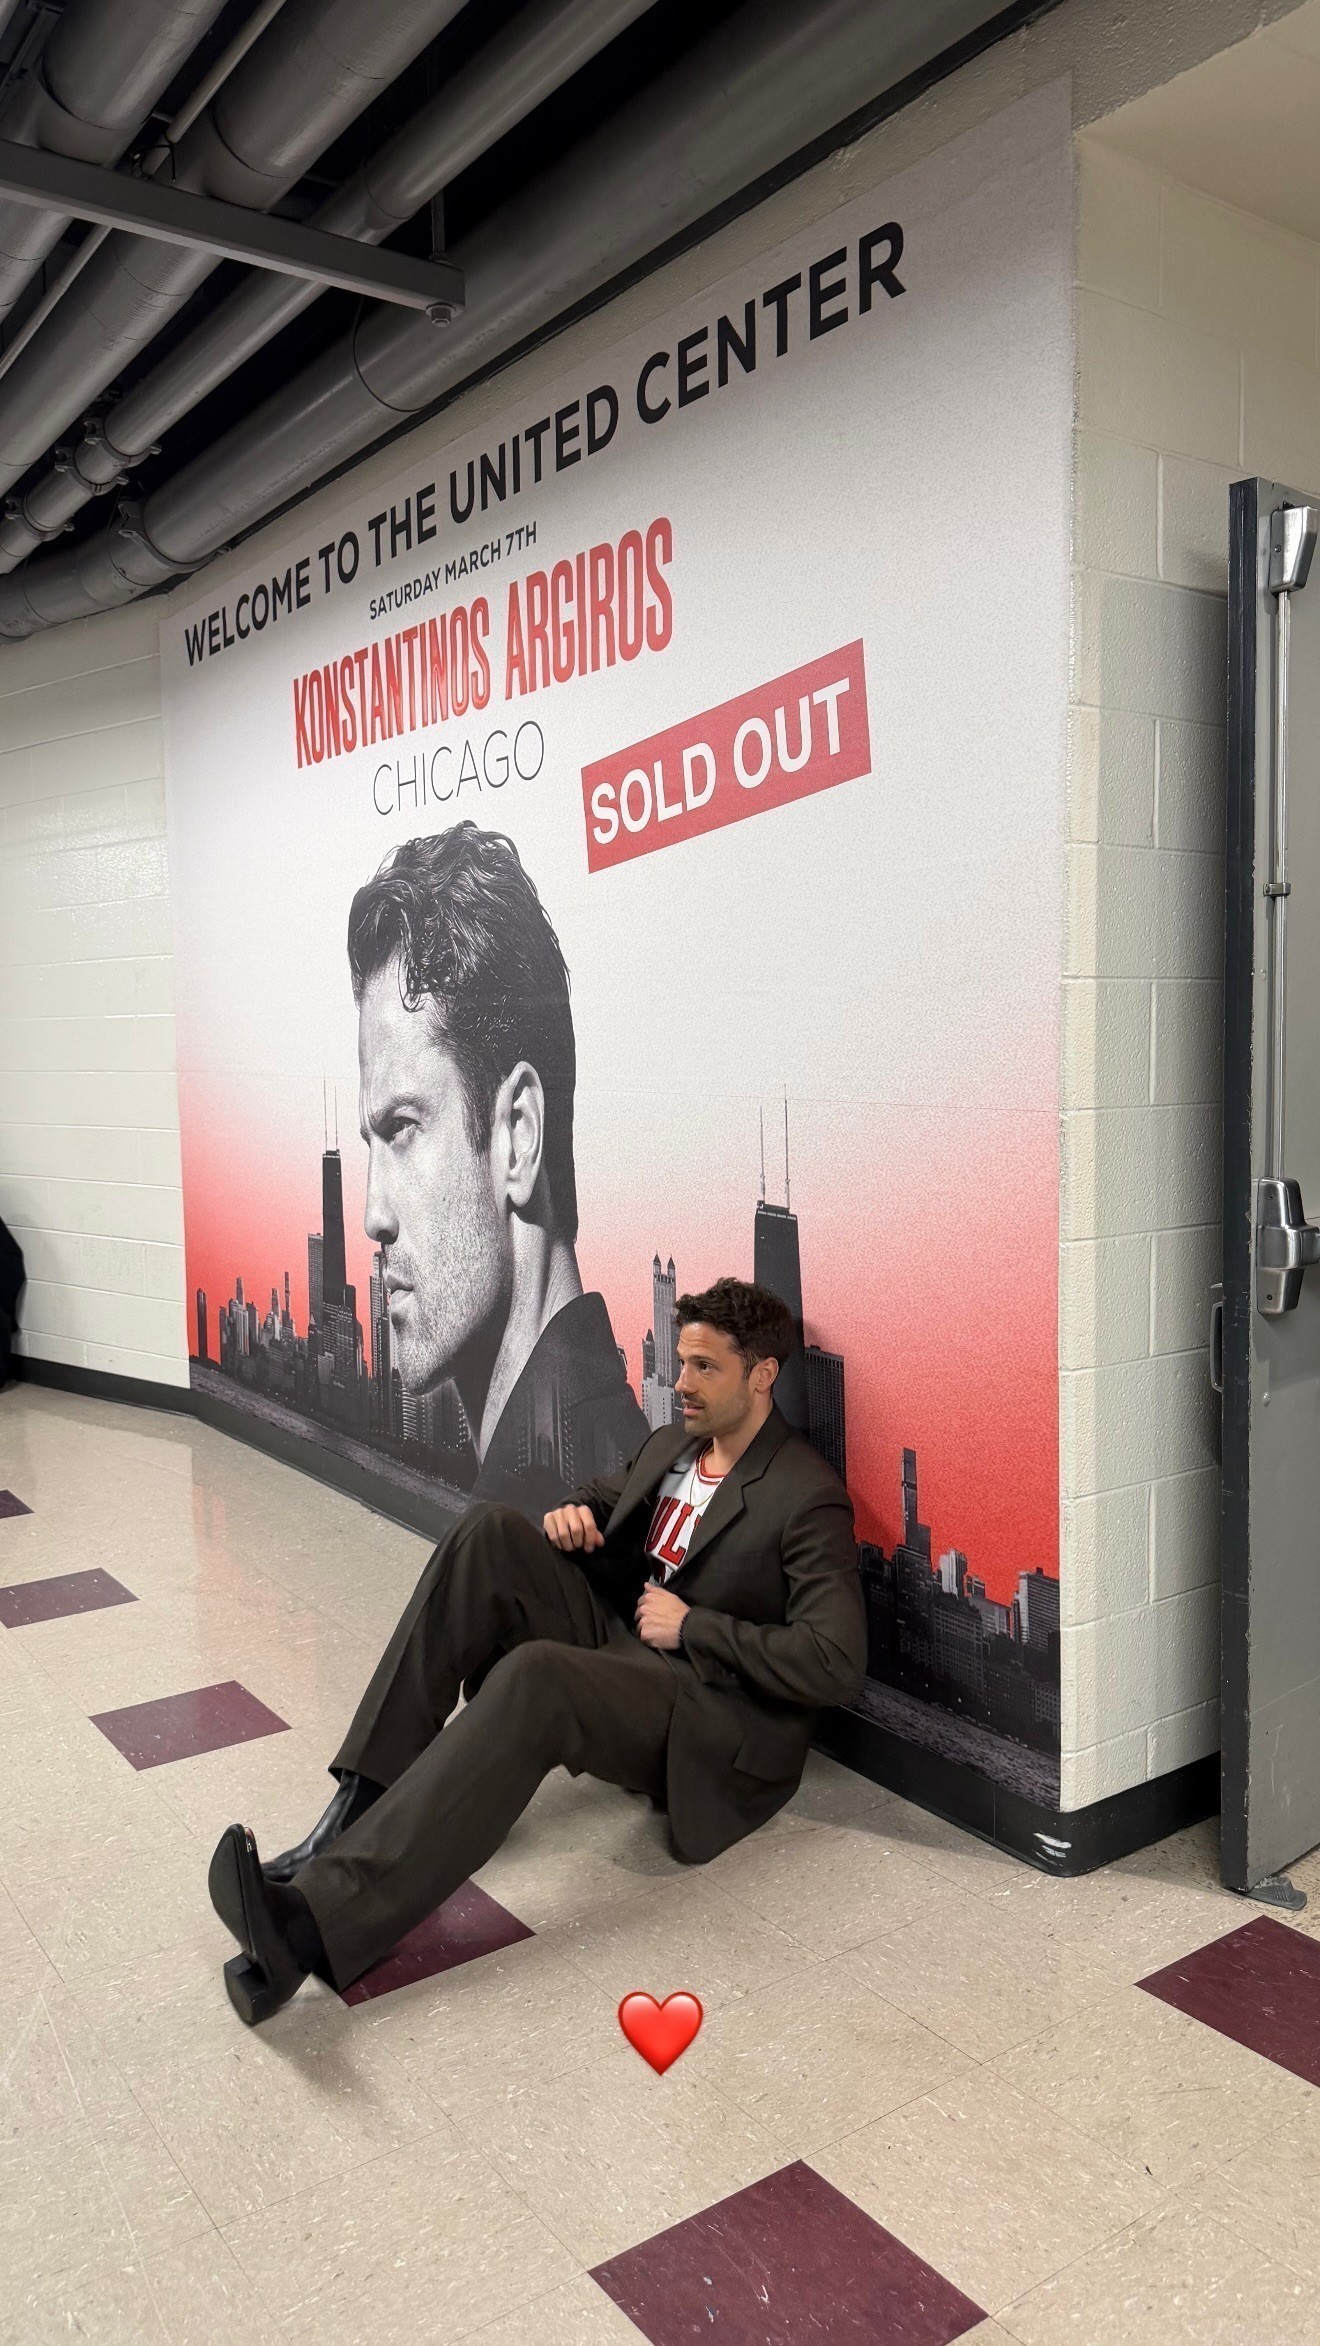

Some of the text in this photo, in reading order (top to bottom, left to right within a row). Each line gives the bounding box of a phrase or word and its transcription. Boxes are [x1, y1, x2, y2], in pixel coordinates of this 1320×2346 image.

[184, 221, 906, 666] WELCOME TO THE UNITED CENTER
[293, 517, 672, 768] KONSTANTINOS ARGIROS
[369, 521, 537, 619] SATURDAY MARCH 7TH
[373, 720, 545, 814] CHICAGO
[591, 676, 849, 845] SOLD OUT
